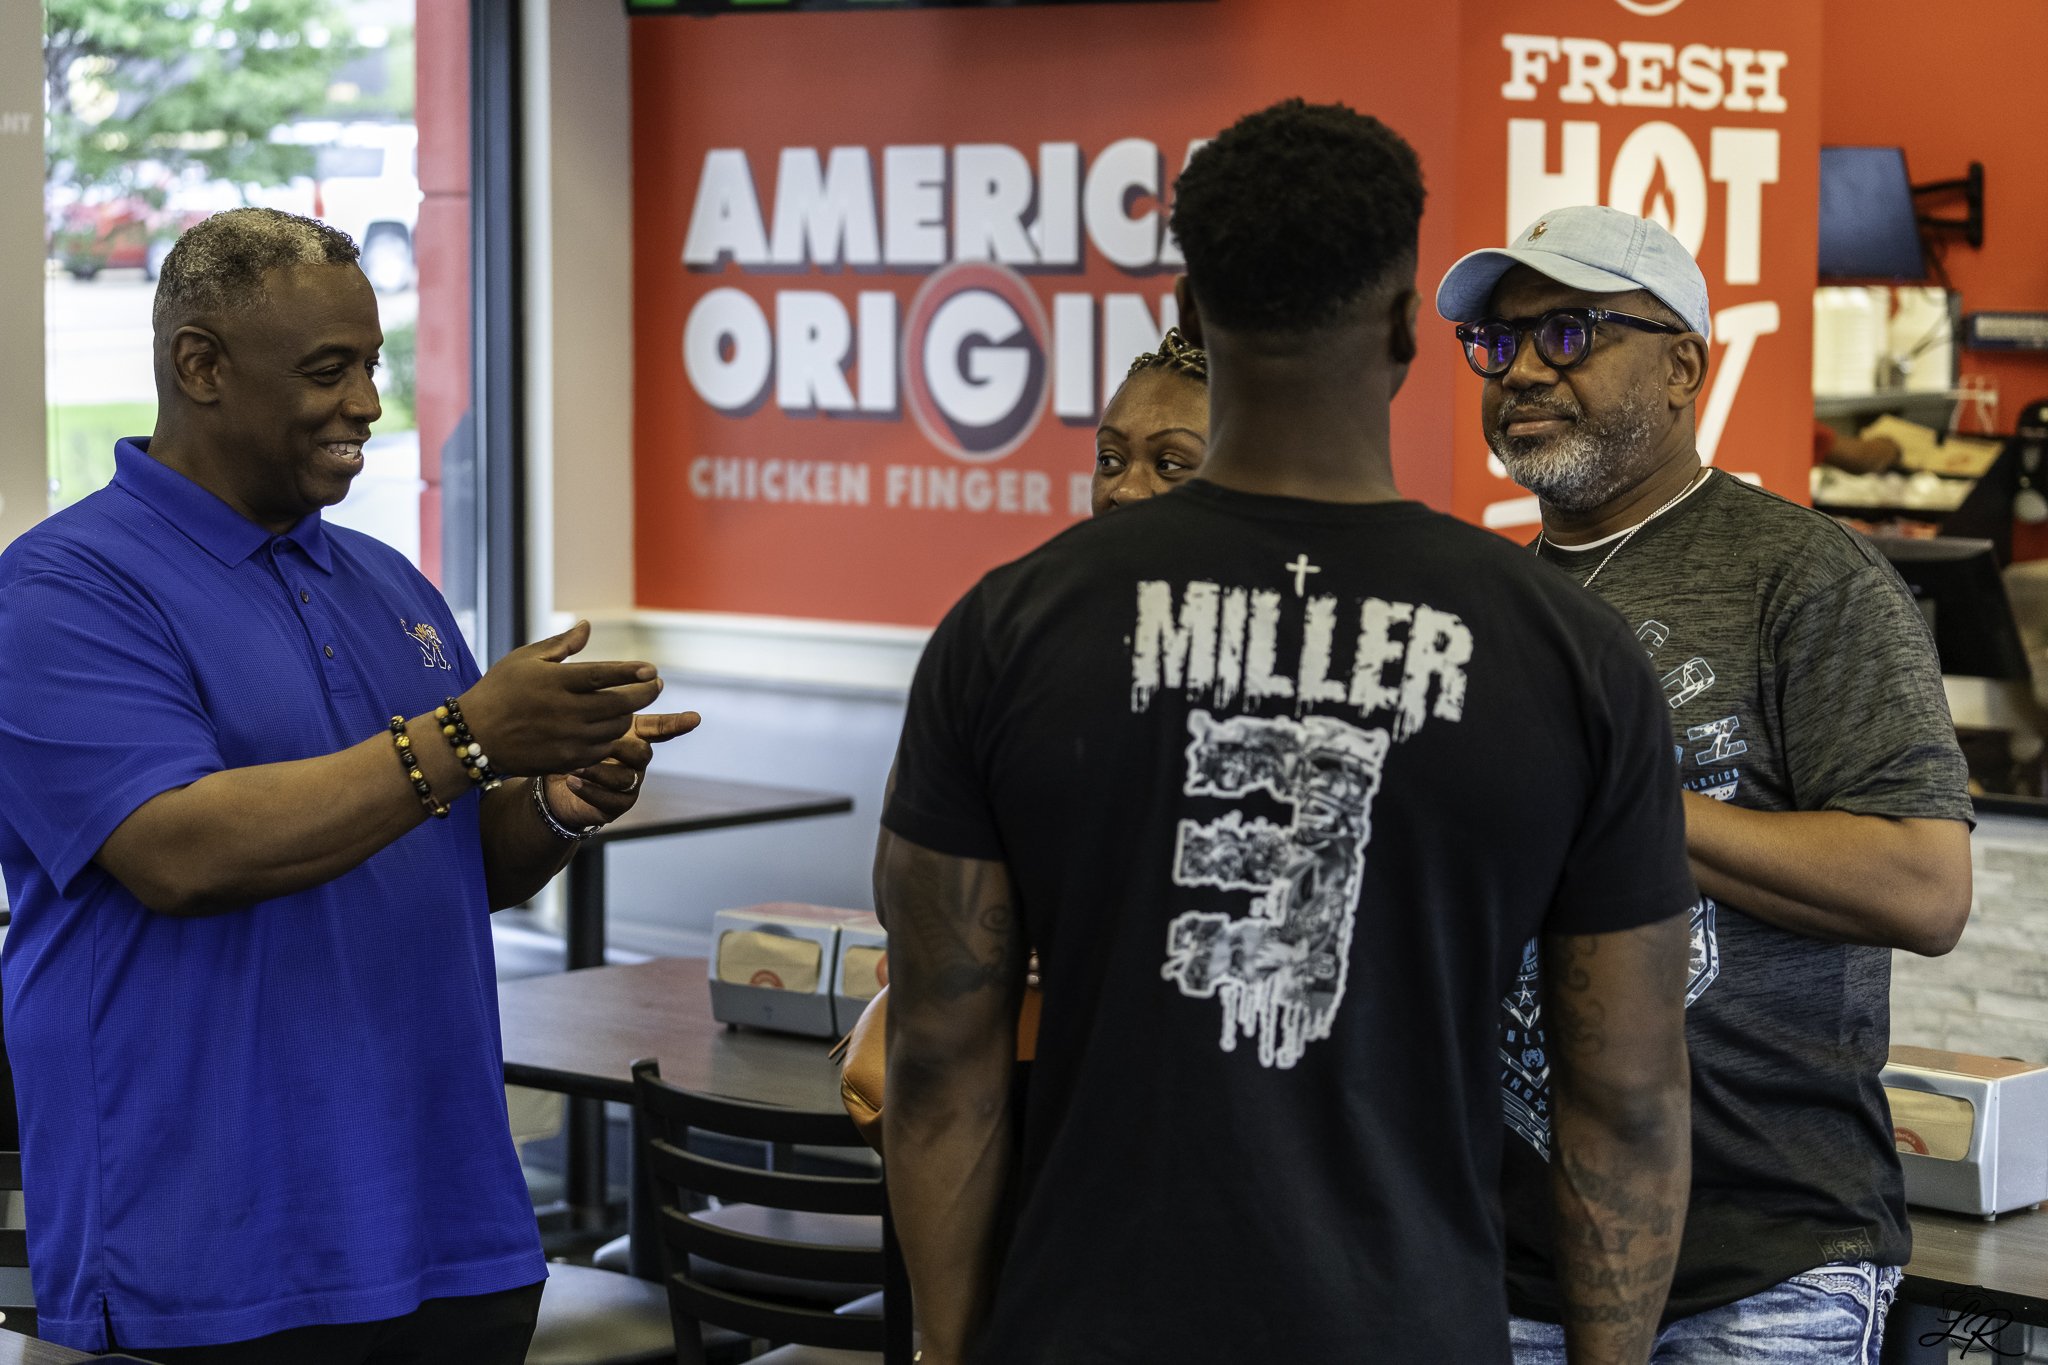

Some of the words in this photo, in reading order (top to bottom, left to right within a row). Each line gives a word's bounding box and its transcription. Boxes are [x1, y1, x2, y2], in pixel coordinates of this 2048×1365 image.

[1501, 33, 1788, 112] FRESH
[1506, 118, 1780, 285] HOT
[689, 457, 869, 506] CHICKEN
[886, 465, 1052, 515] FINGER
[1130, 579, 1473, 743] MILLER
[1162, 709, 1390, 1069] 3
